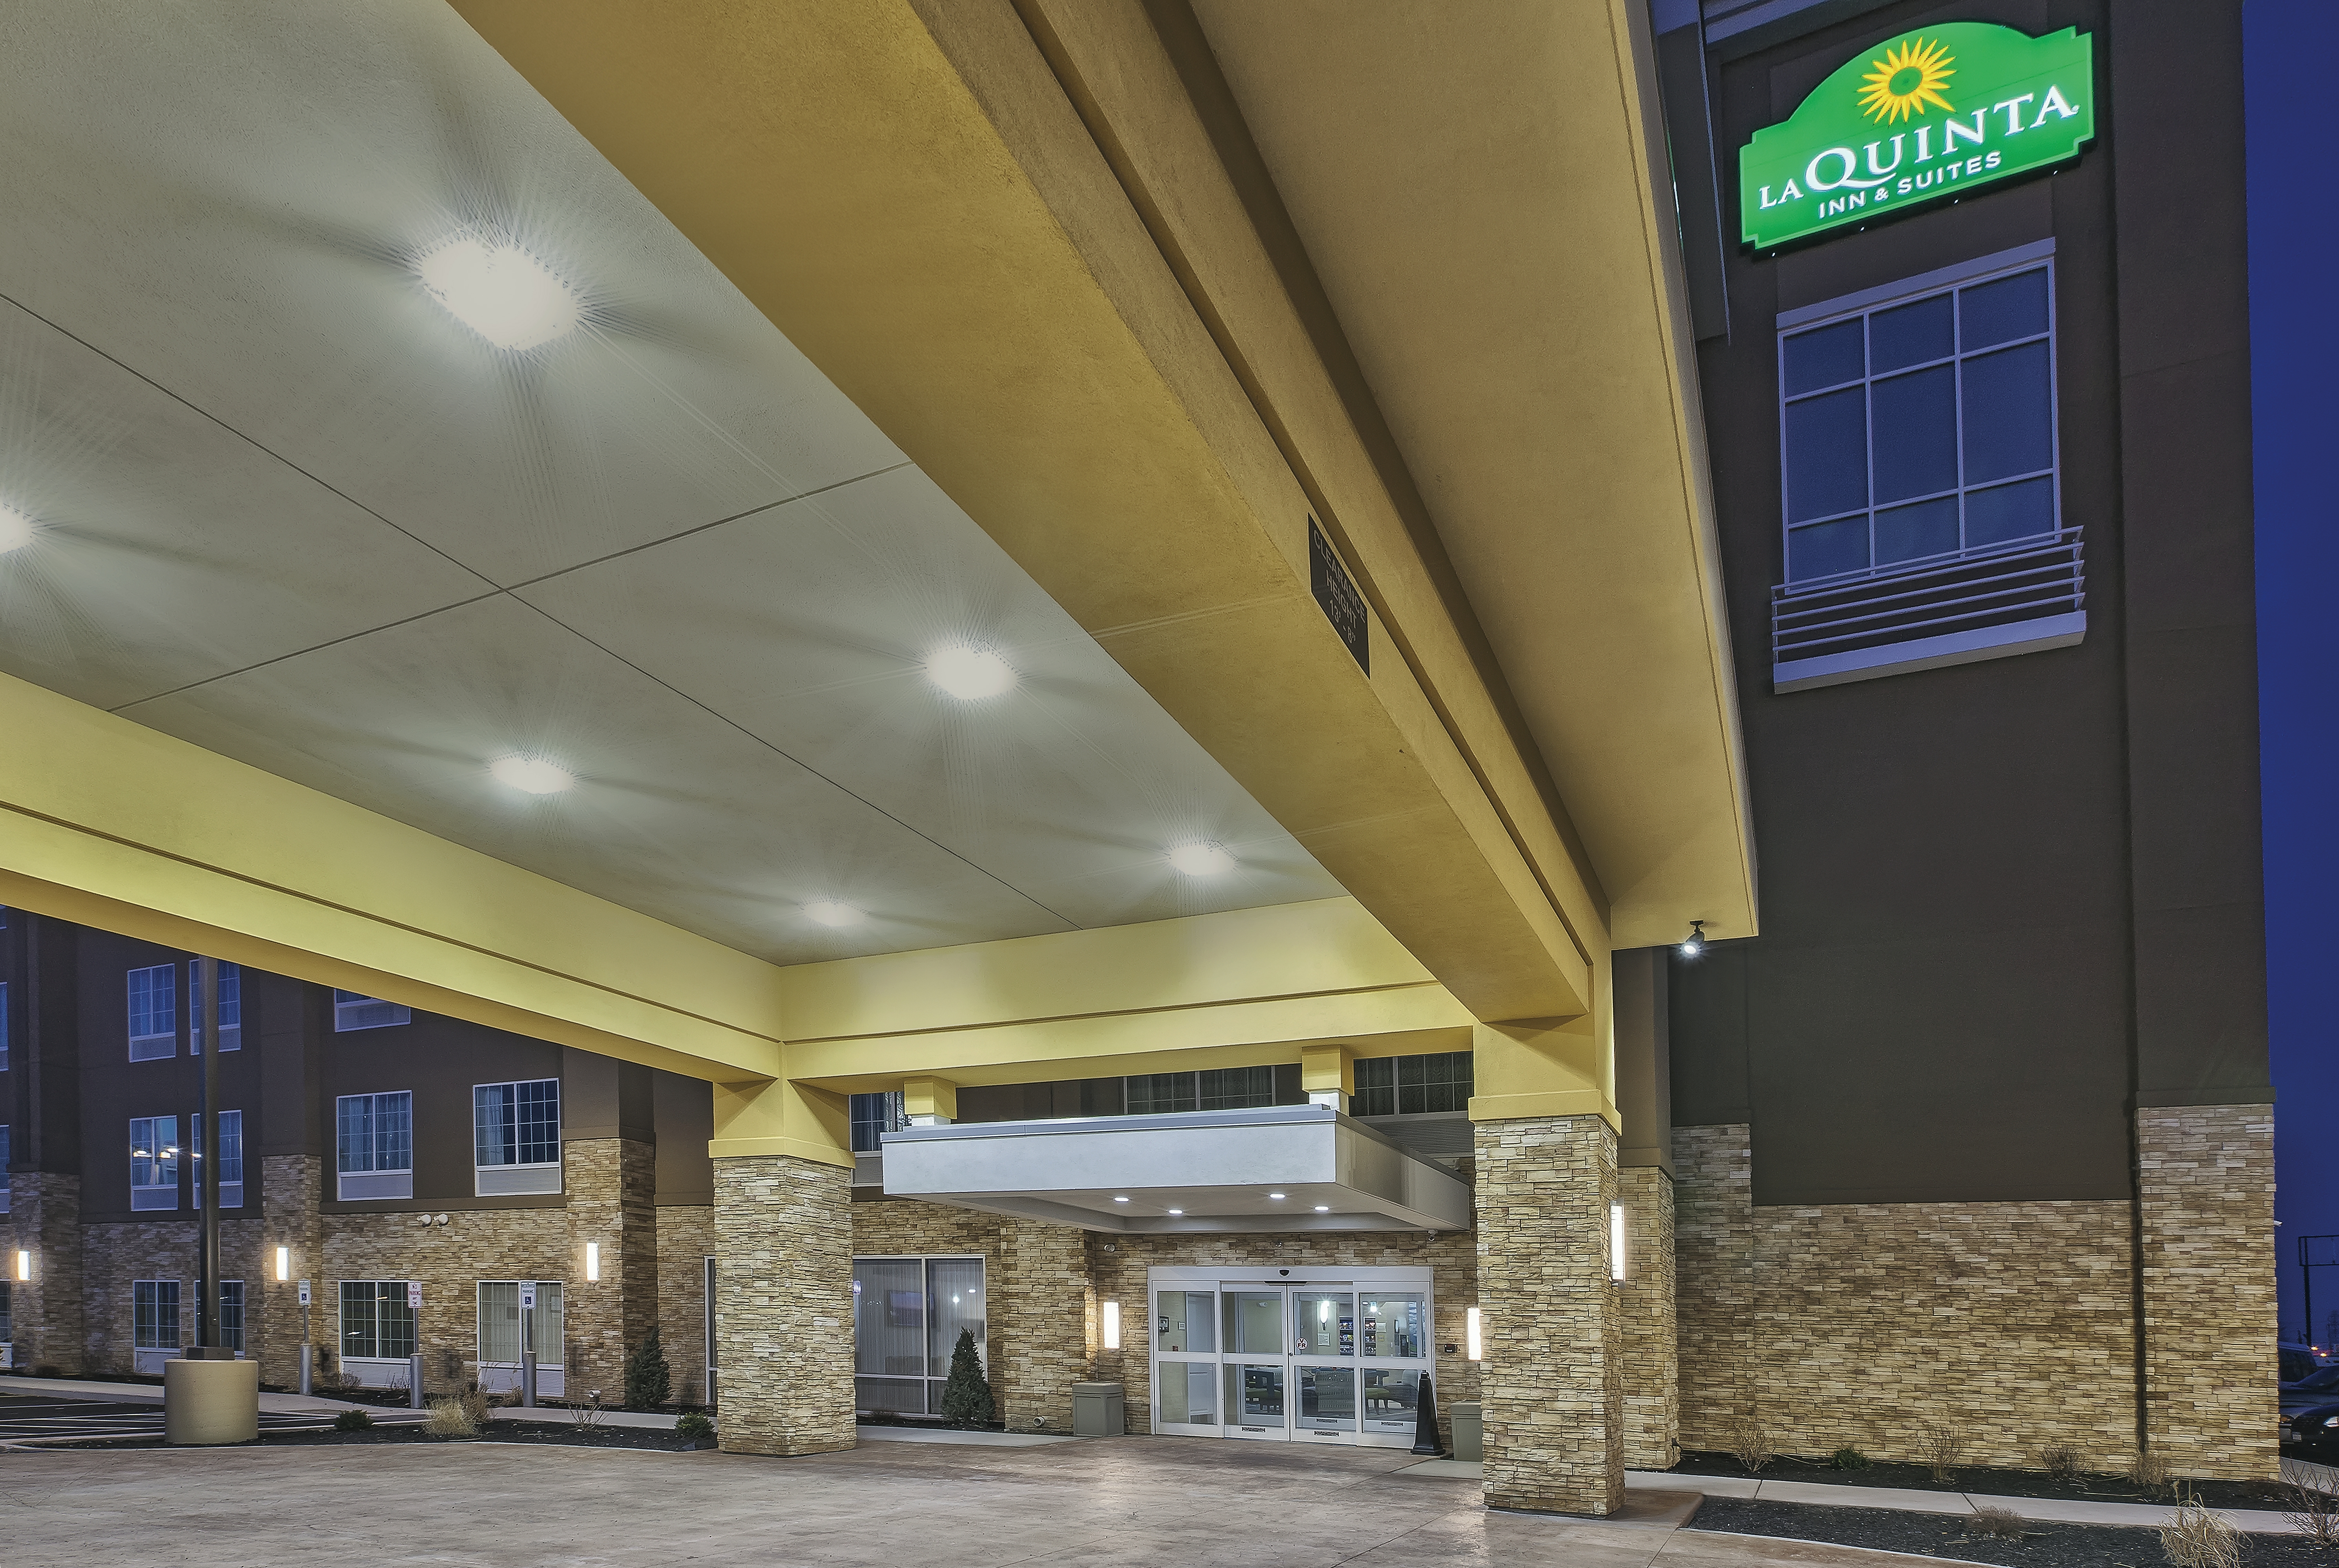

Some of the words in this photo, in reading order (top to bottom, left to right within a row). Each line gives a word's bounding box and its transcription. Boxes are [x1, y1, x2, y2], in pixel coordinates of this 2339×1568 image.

[1759, 178, 1803, 209] LA
[1805, 84, 2080, 191] QUINTA
[1819, 191, 1866, 219] INN
[1874, 181, 1889, 201] &
[1897, 151, 2002, 195] SUITES
[1313, 530, 1365, 623] CLEARANCE
[1325, 569, 1357, 629] HEIGHT
[1329, 599, 1341, 623] 13'
